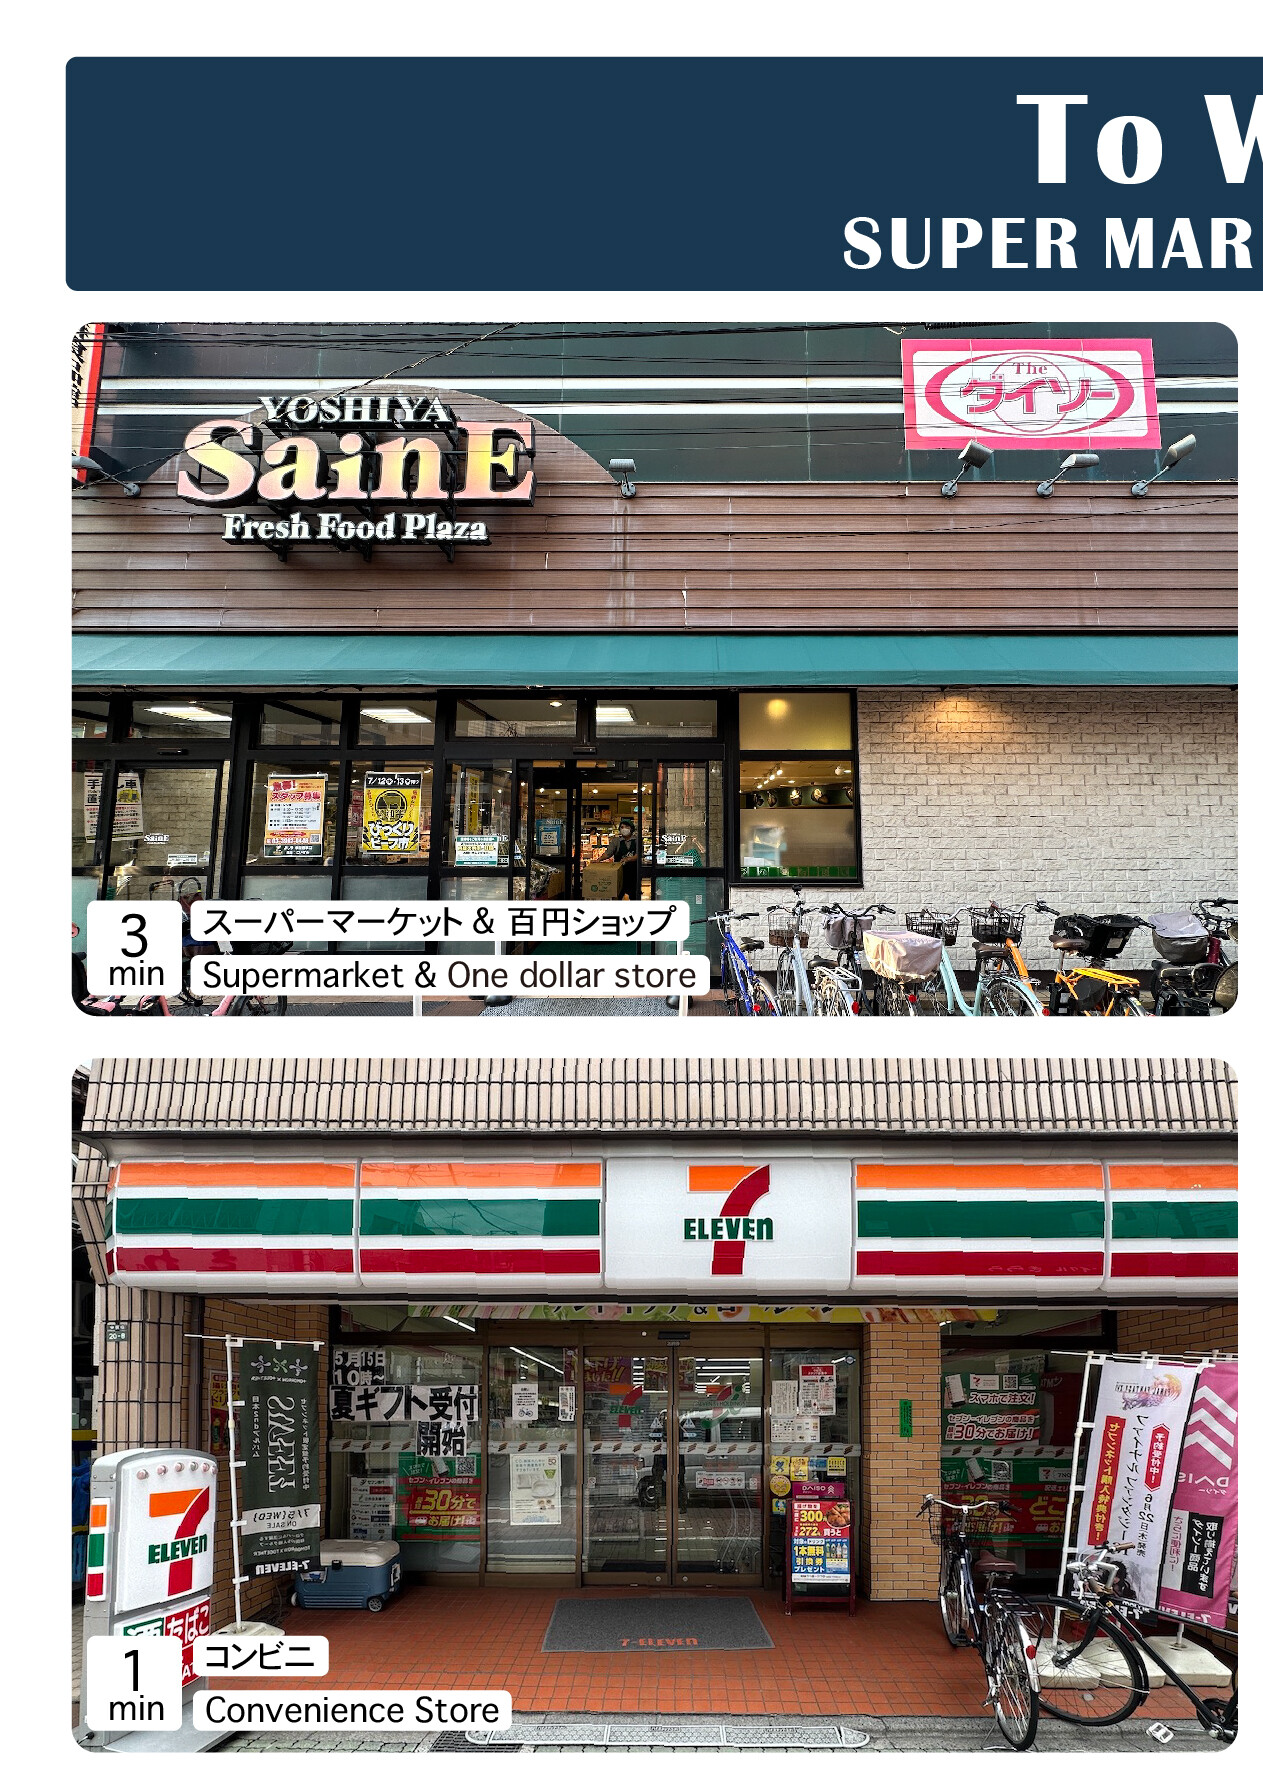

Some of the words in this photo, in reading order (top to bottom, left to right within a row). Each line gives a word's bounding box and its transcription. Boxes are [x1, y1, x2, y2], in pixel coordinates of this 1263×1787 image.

[1012, 361, 1048, 375] The
[258, 395, 453, 424] YOSHIYA
[959, 373, 1116, 415] ダイソー
[222, 513, 310, 540] Fresh
[317, 513, 397, 540] Food
[404, 513, 488, 541] Plaza
[687, 1164, 771, 1276] 7
[334, 1350, 385, 1367] 5月15日
[330, 1386, 478, 1421] 夏ギフト受付
[417, 1421, 467, 1457] 開始
[149, 1486, 210, 1597] 7
[793, 1545, 824, 1556] 1本無料
